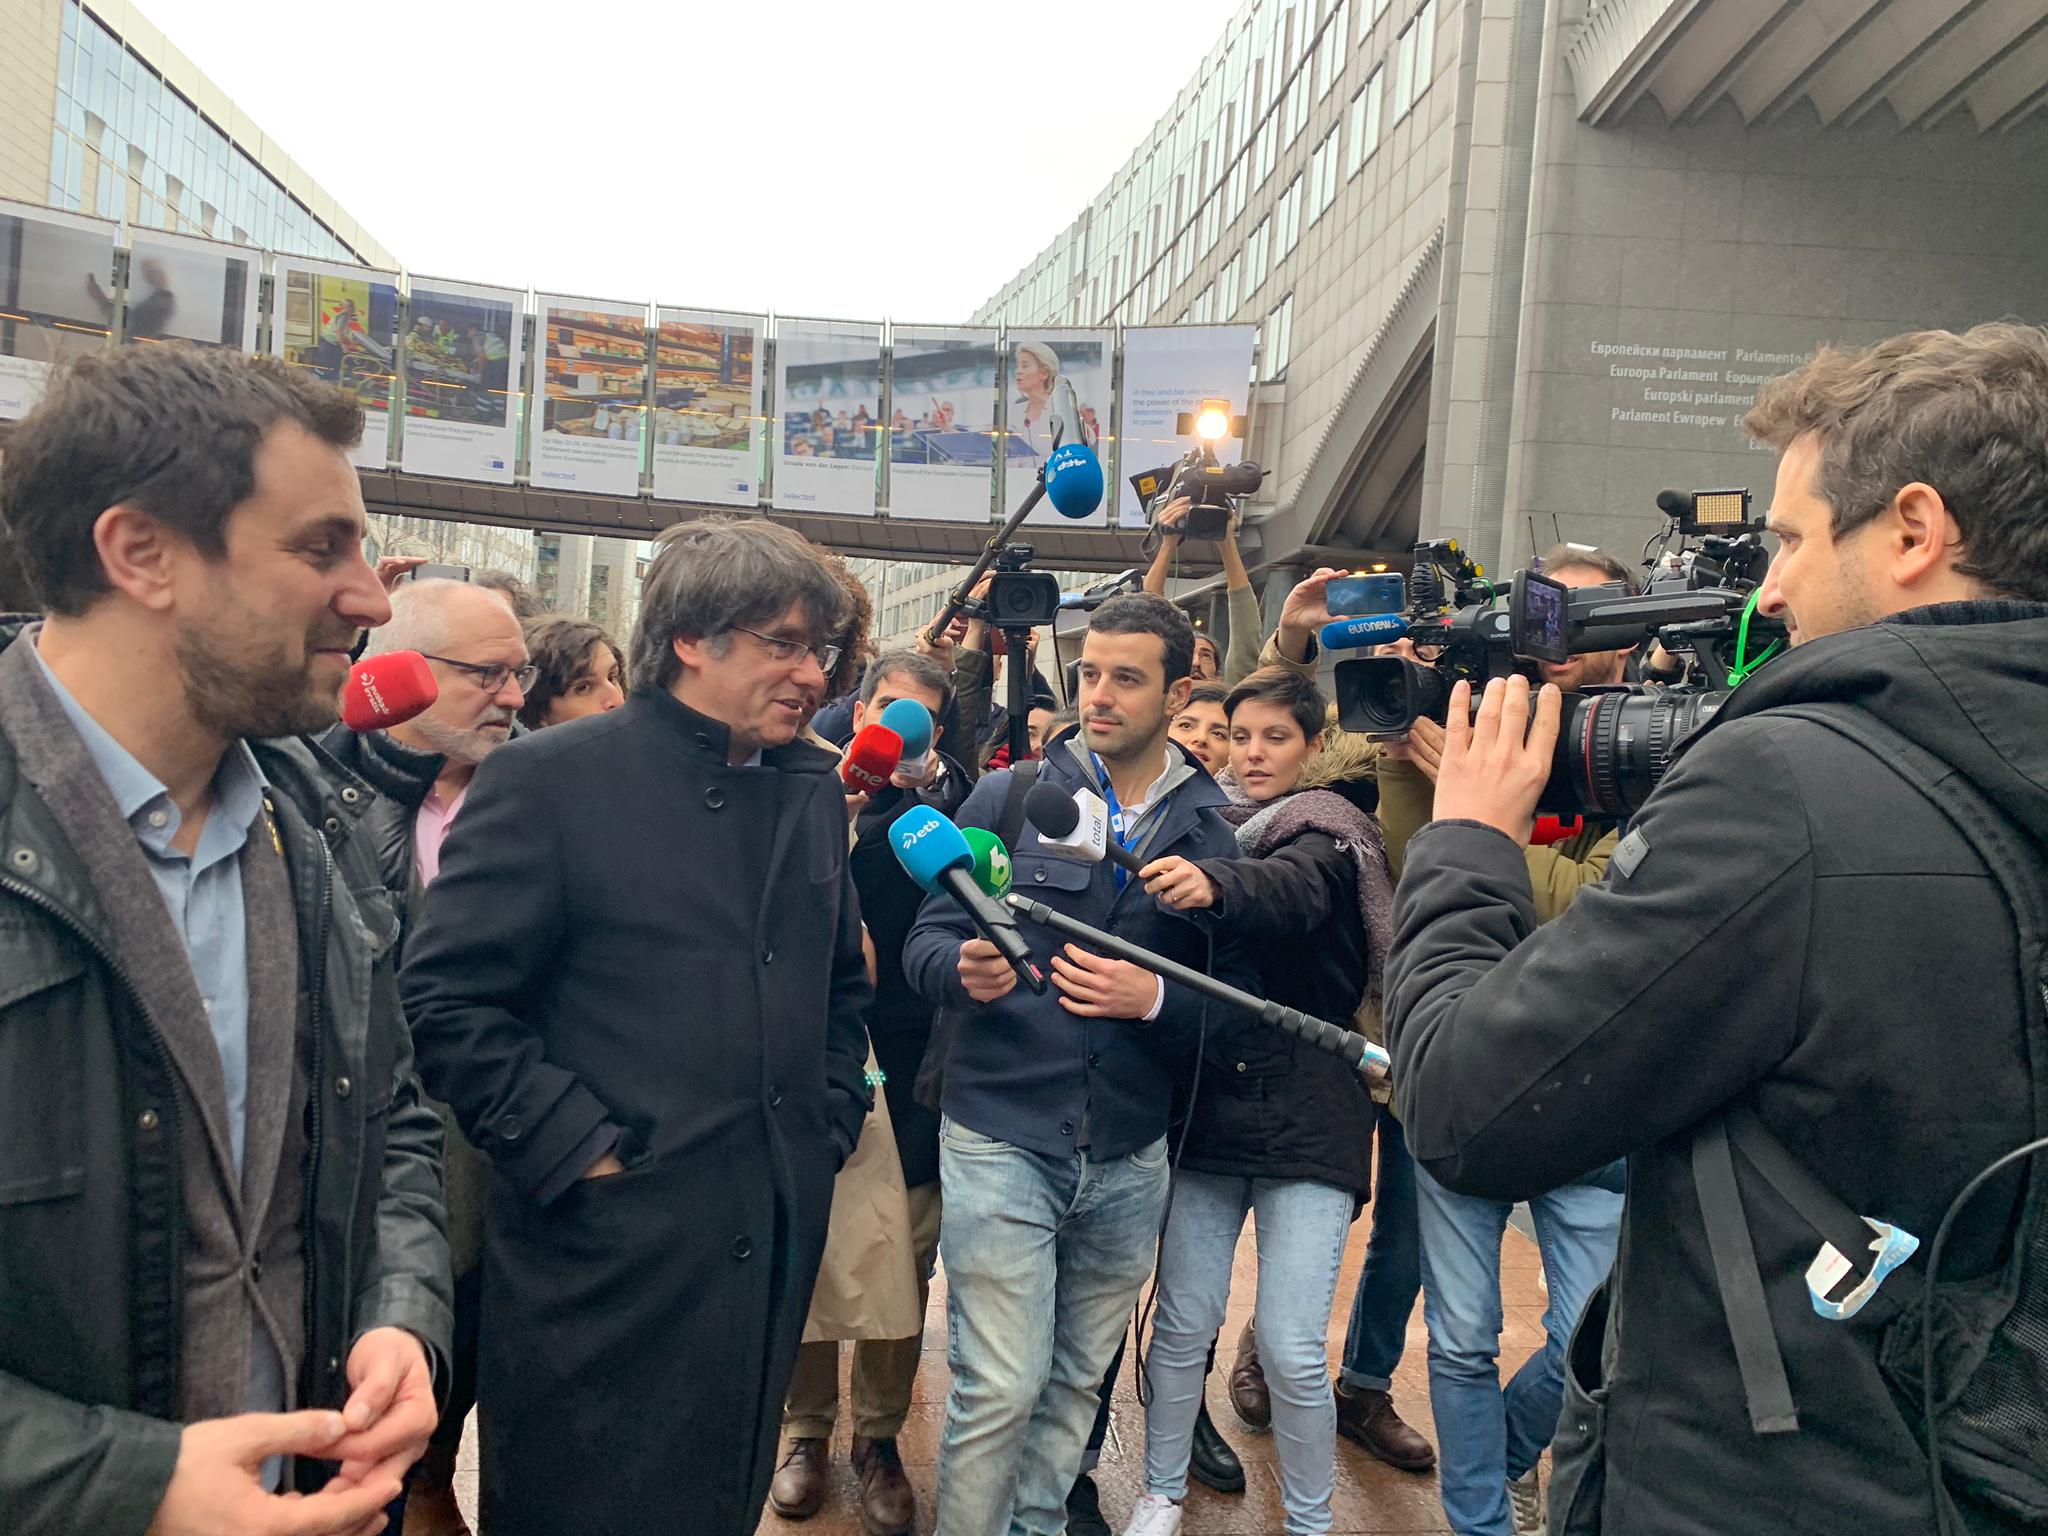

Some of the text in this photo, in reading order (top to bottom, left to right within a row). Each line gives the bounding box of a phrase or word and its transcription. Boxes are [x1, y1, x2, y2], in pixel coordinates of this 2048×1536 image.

[1590, 340, 1728, 361] Европейски парламент
[1736, 348, 1800, 365] Parlamento
[1610, 364, 1719, 382] Euroopa Parlament
[1146, 399, 1170, 407] power
[1644, 387, 1754, 406] Europski parlament
[1612, 407, 1670, 423] Parlament
[1673, 411, 1727, 428] Ewropew
[371, 685, 390, 714] euskadi
[848, 763, 883, 786] rne
[916, 820, 941, 838] etb
[1092, 815, 1102, 847] total
